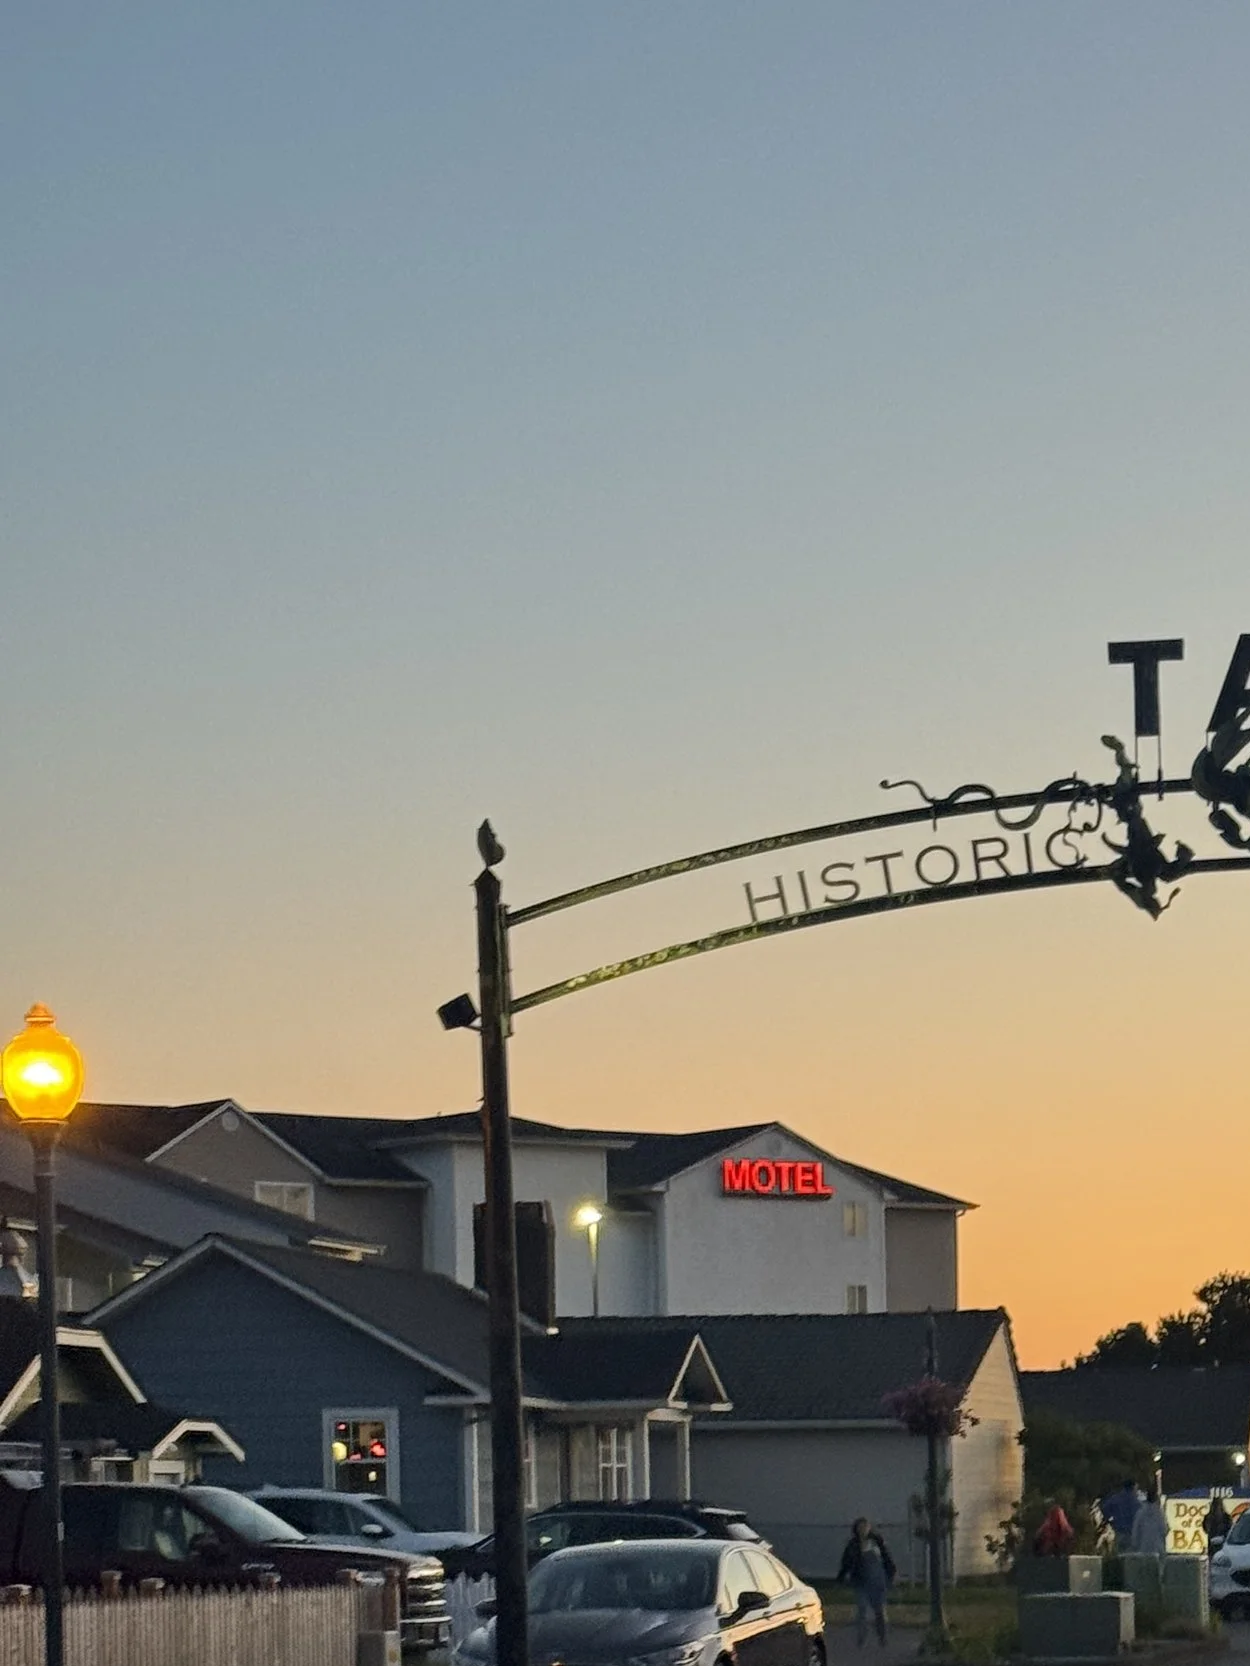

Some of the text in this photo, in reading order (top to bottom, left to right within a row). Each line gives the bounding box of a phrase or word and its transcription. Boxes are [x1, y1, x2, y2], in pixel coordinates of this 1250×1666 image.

[743, 826, 1086, 923] HISTORIC
[721, 1156, 836, 1196] MOTEL
[1175, 1503, 1207, 1517] Doc
[1173, 1531, 1204, 1549] BA
